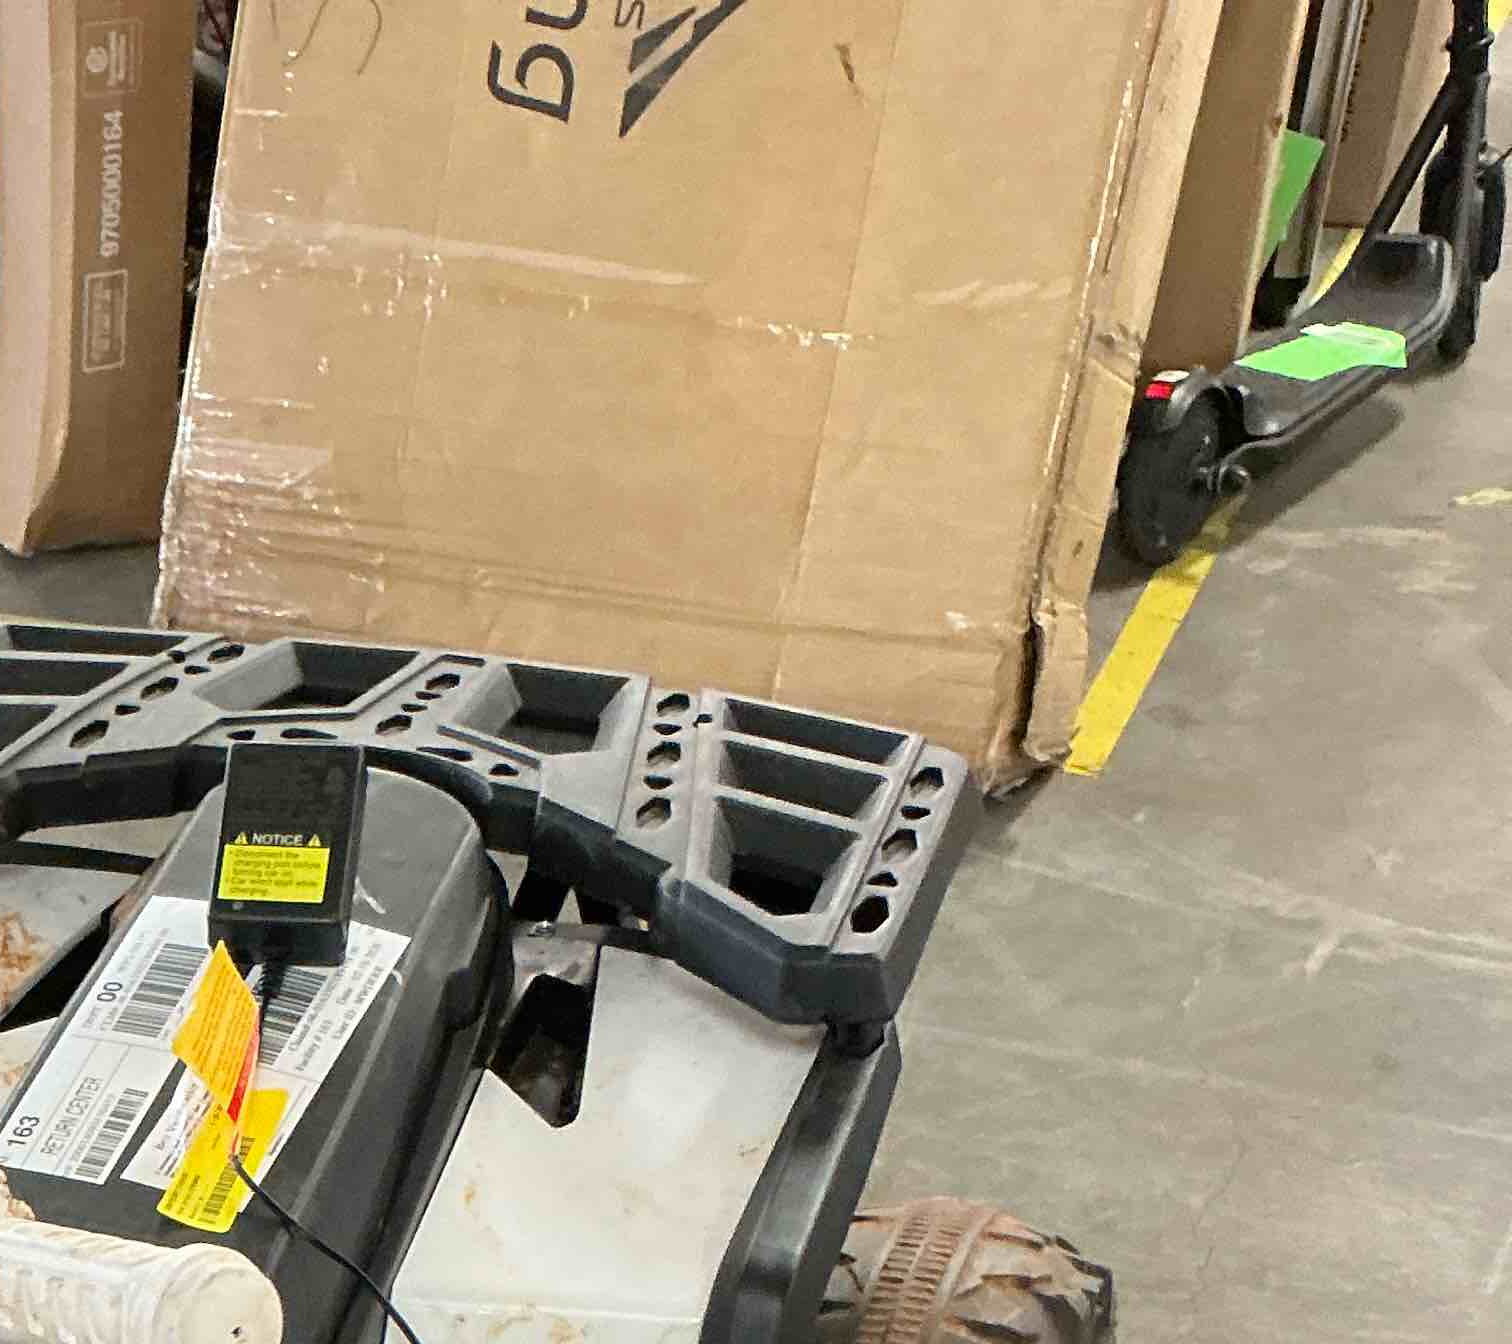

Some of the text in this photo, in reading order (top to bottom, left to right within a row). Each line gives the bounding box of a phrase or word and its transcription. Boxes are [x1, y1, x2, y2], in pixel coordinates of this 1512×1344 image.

[251, 832, 303, 846] NOTICE
[96, 981, 123, 1002] 00
[7, 1115, 40, 1146] 163
